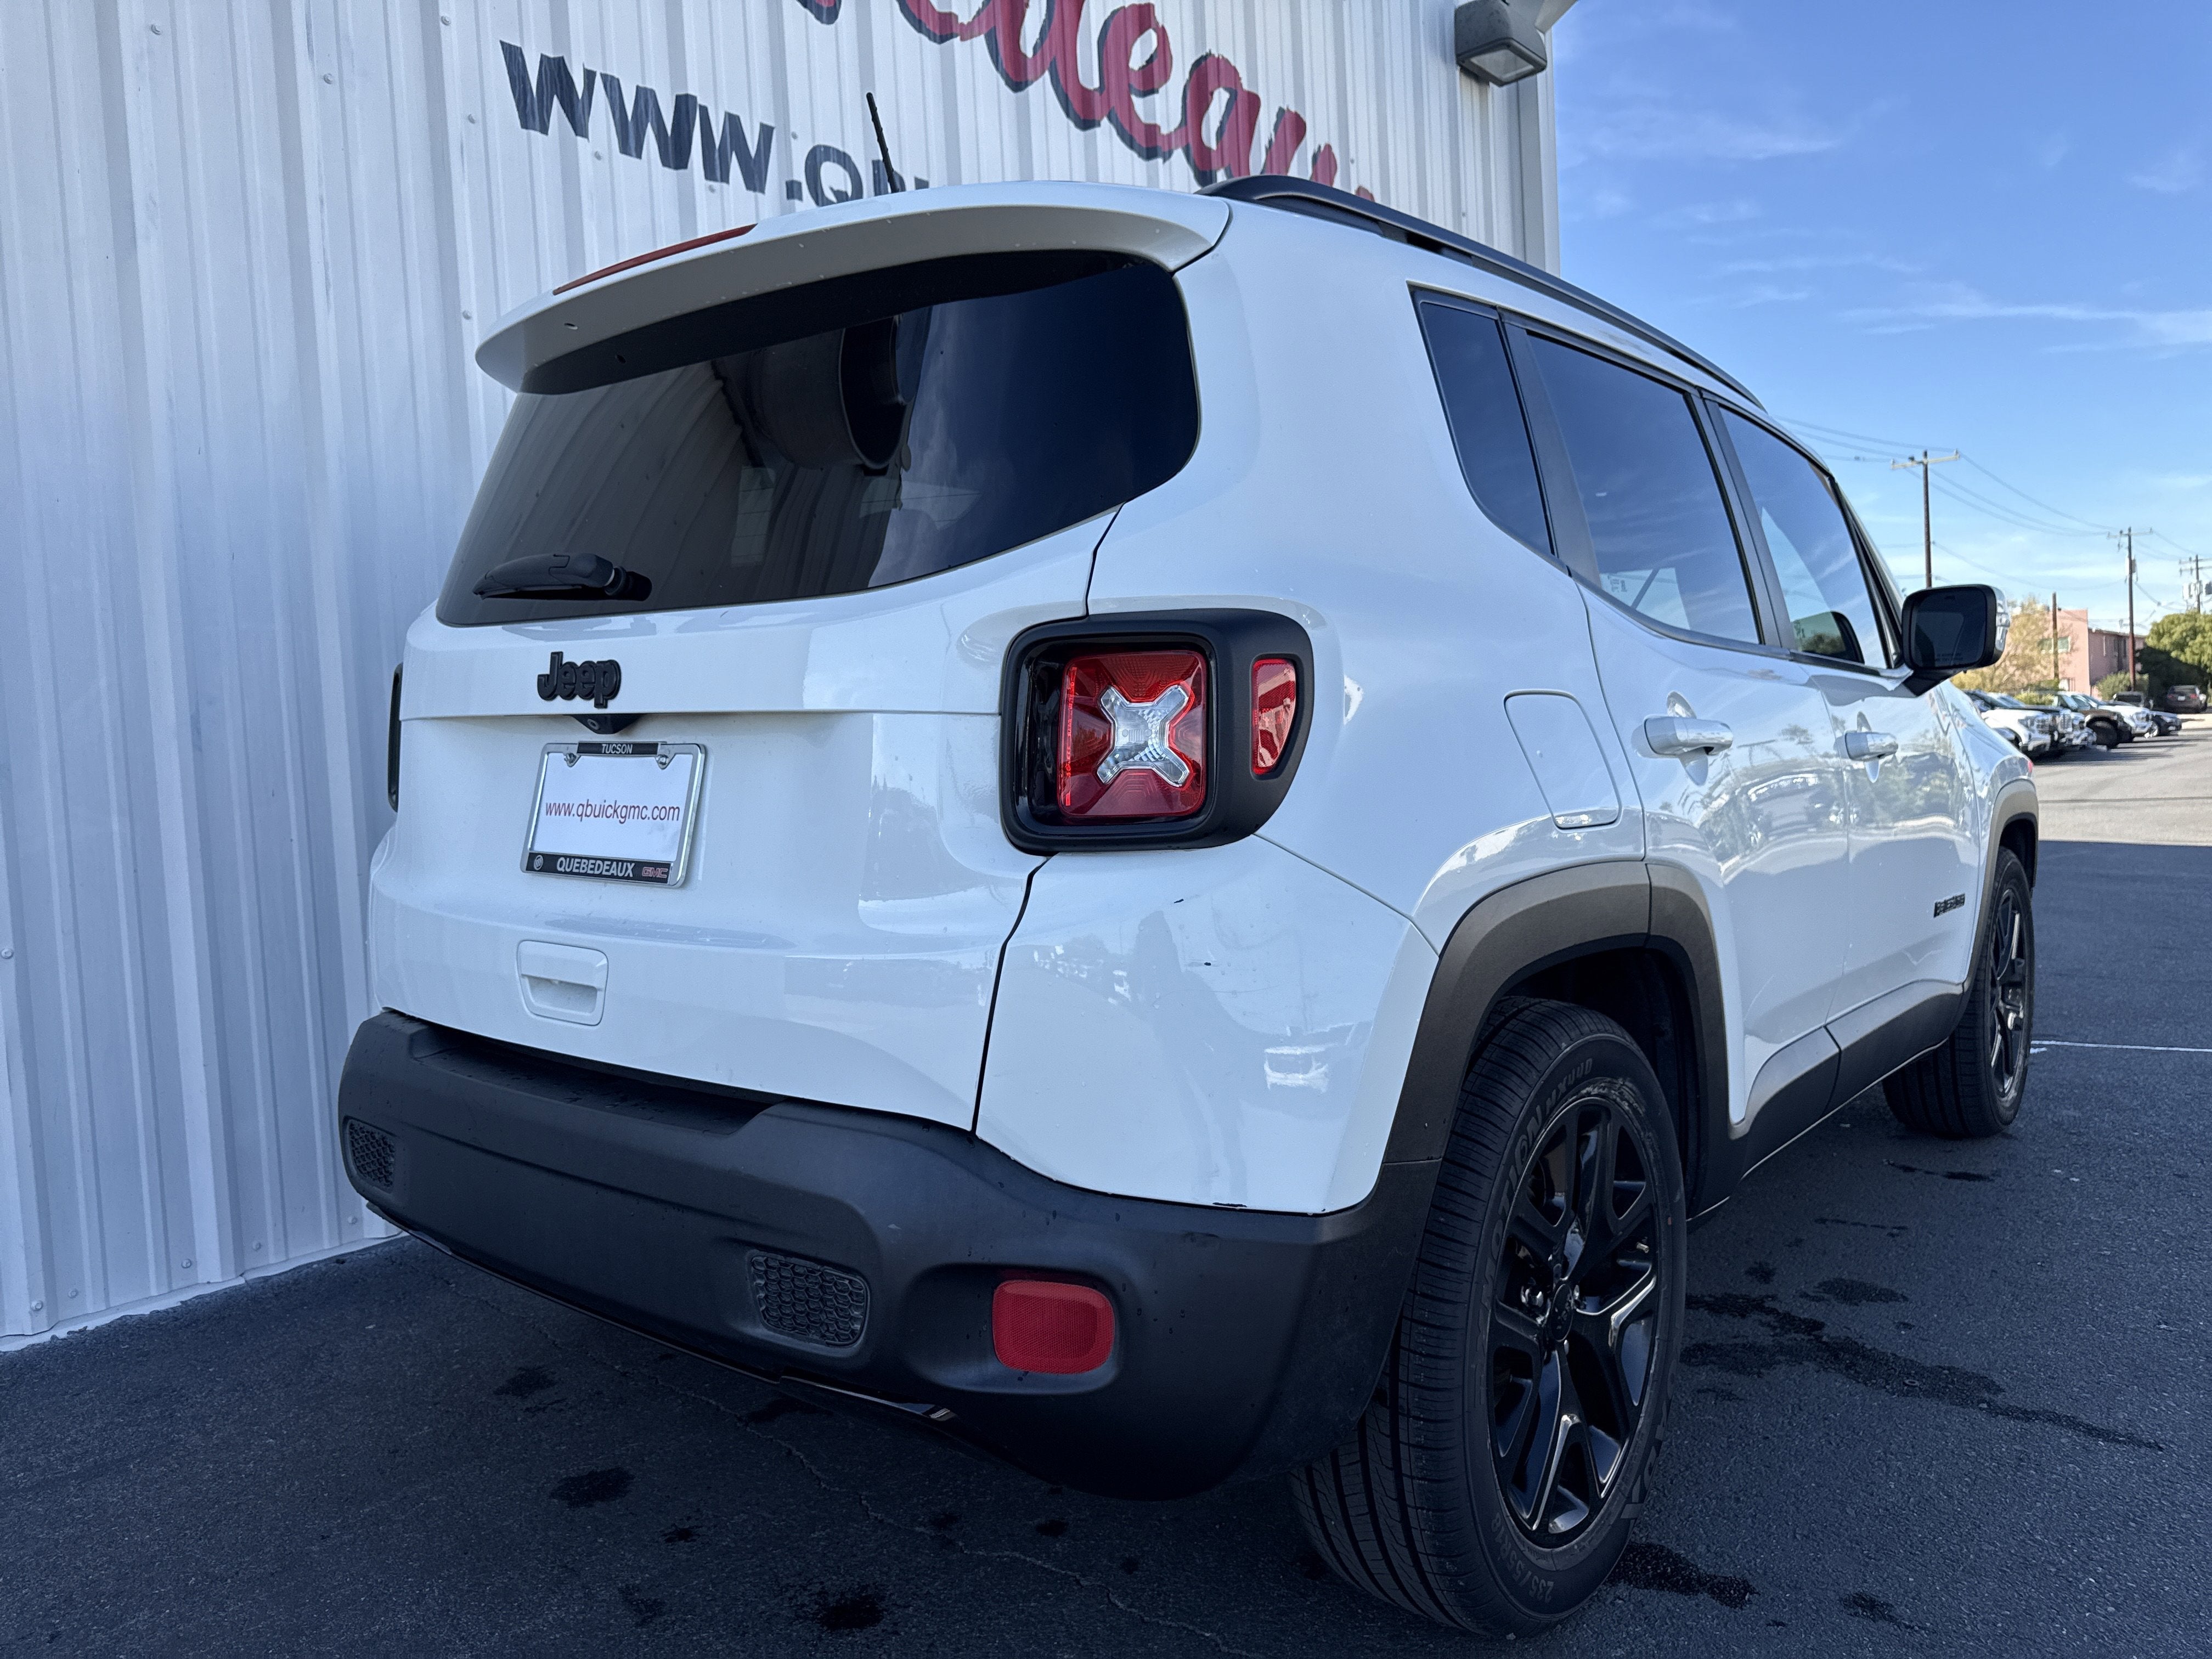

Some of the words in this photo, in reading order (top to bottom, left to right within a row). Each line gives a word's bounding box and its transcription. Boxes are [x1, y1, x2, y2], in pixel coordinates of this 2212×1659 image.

[537, 651, 622, 709] Jeep
[602, 743, 633, 754] TUCSON
[545, 799, 680, 823] www.qbuickgmc.com
[557, 857, 635, 878] QUEBEDEAUX
[642, 866, 668, 878] GMC
